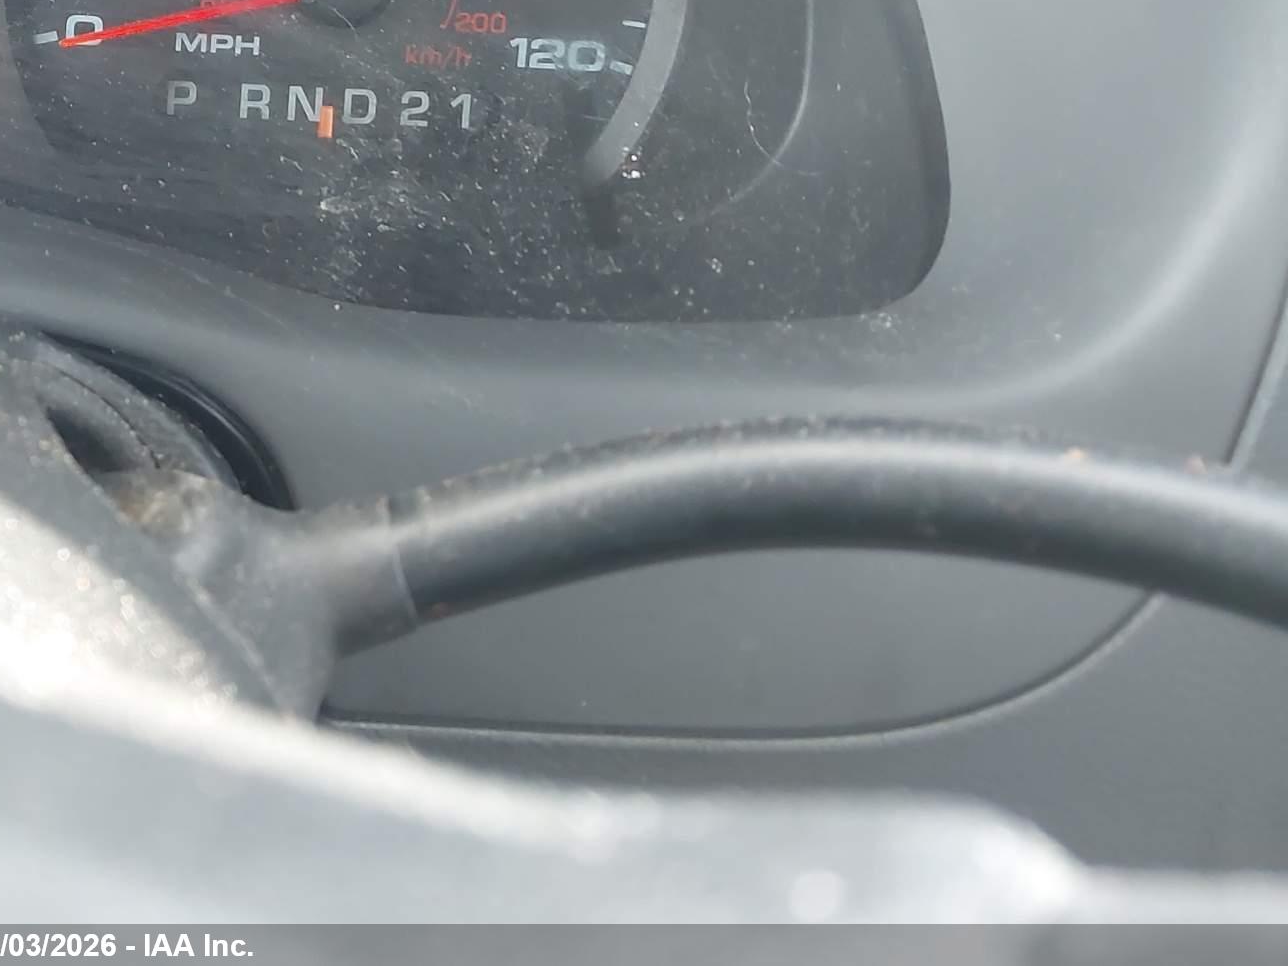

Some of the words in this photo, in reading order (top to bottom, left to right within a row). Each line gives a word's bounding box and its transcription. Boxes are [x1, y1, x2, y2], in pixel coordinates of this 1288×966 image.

[65, 14, 104, 46] 0
[455, 12, 507, 34] 200
[175, 32, 261, 56] MPH
[405, 44, 473, 67] km/h
[509, 37, 606, 72] 120
[166, 80, 198, 116] P
[238, 83, 272, 120] R
[286, 85, 324, 123] N
[342, 88, 378, 125] D
[399, 91, 431, 128] 2
[449, 93, 473, 130] 1
